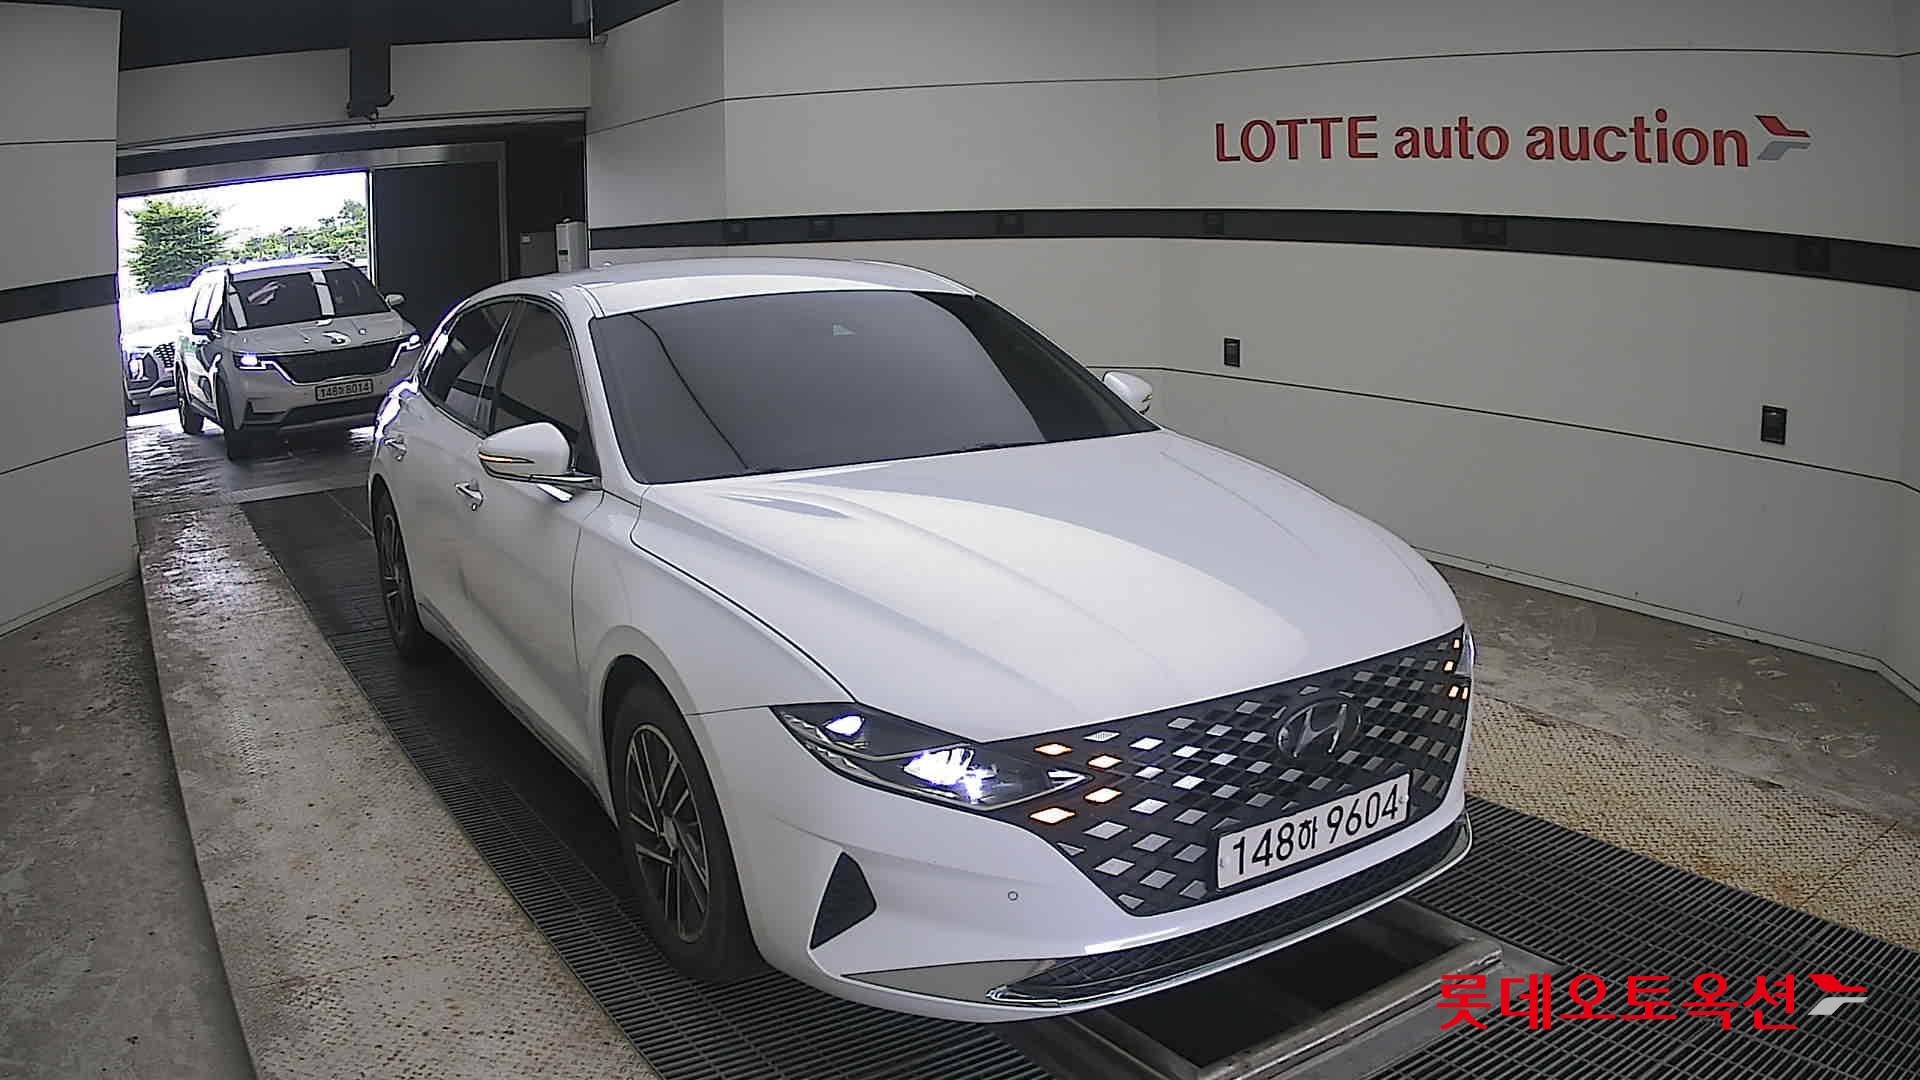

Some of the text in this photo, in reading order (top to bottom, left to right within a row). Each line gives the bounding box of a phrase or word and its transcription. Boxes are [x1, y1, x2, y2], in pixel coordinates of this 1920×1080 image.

[1216, 109, 1749, 167] LOTTE auto auction
[1233, 784, 1398, 875] 148하 9604
